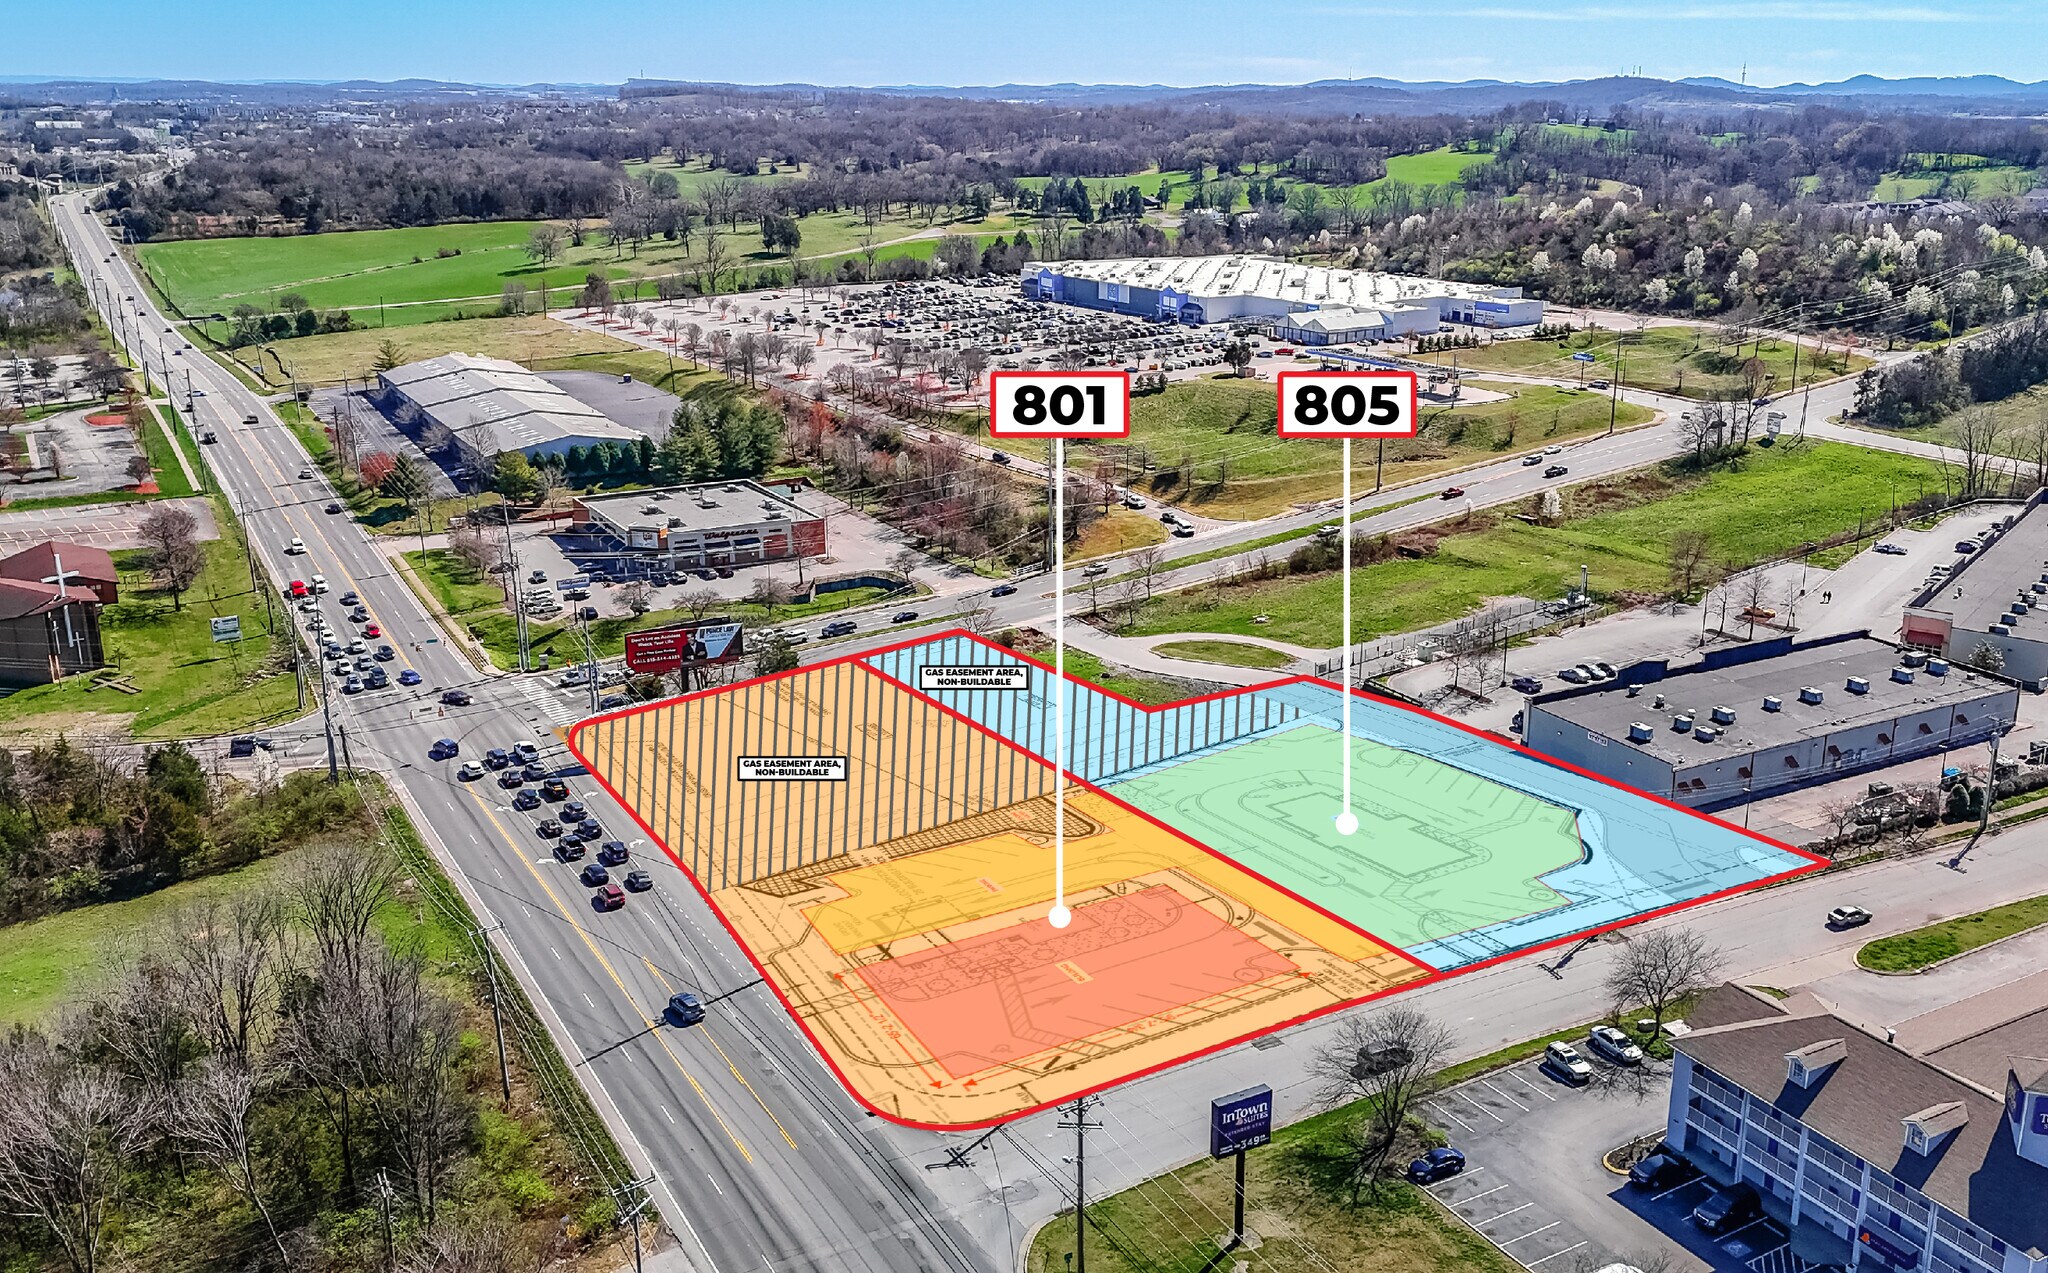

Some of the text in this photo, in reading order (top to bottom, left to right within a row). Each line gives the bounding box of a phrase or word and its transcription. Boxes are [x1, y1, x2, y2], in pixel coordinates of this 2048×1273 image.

[703, 528, 759, 540] Walgreens
[1222, 1102, 1268, 1124] InTown
[1243, 1111, 1268, 1124] SUITES
